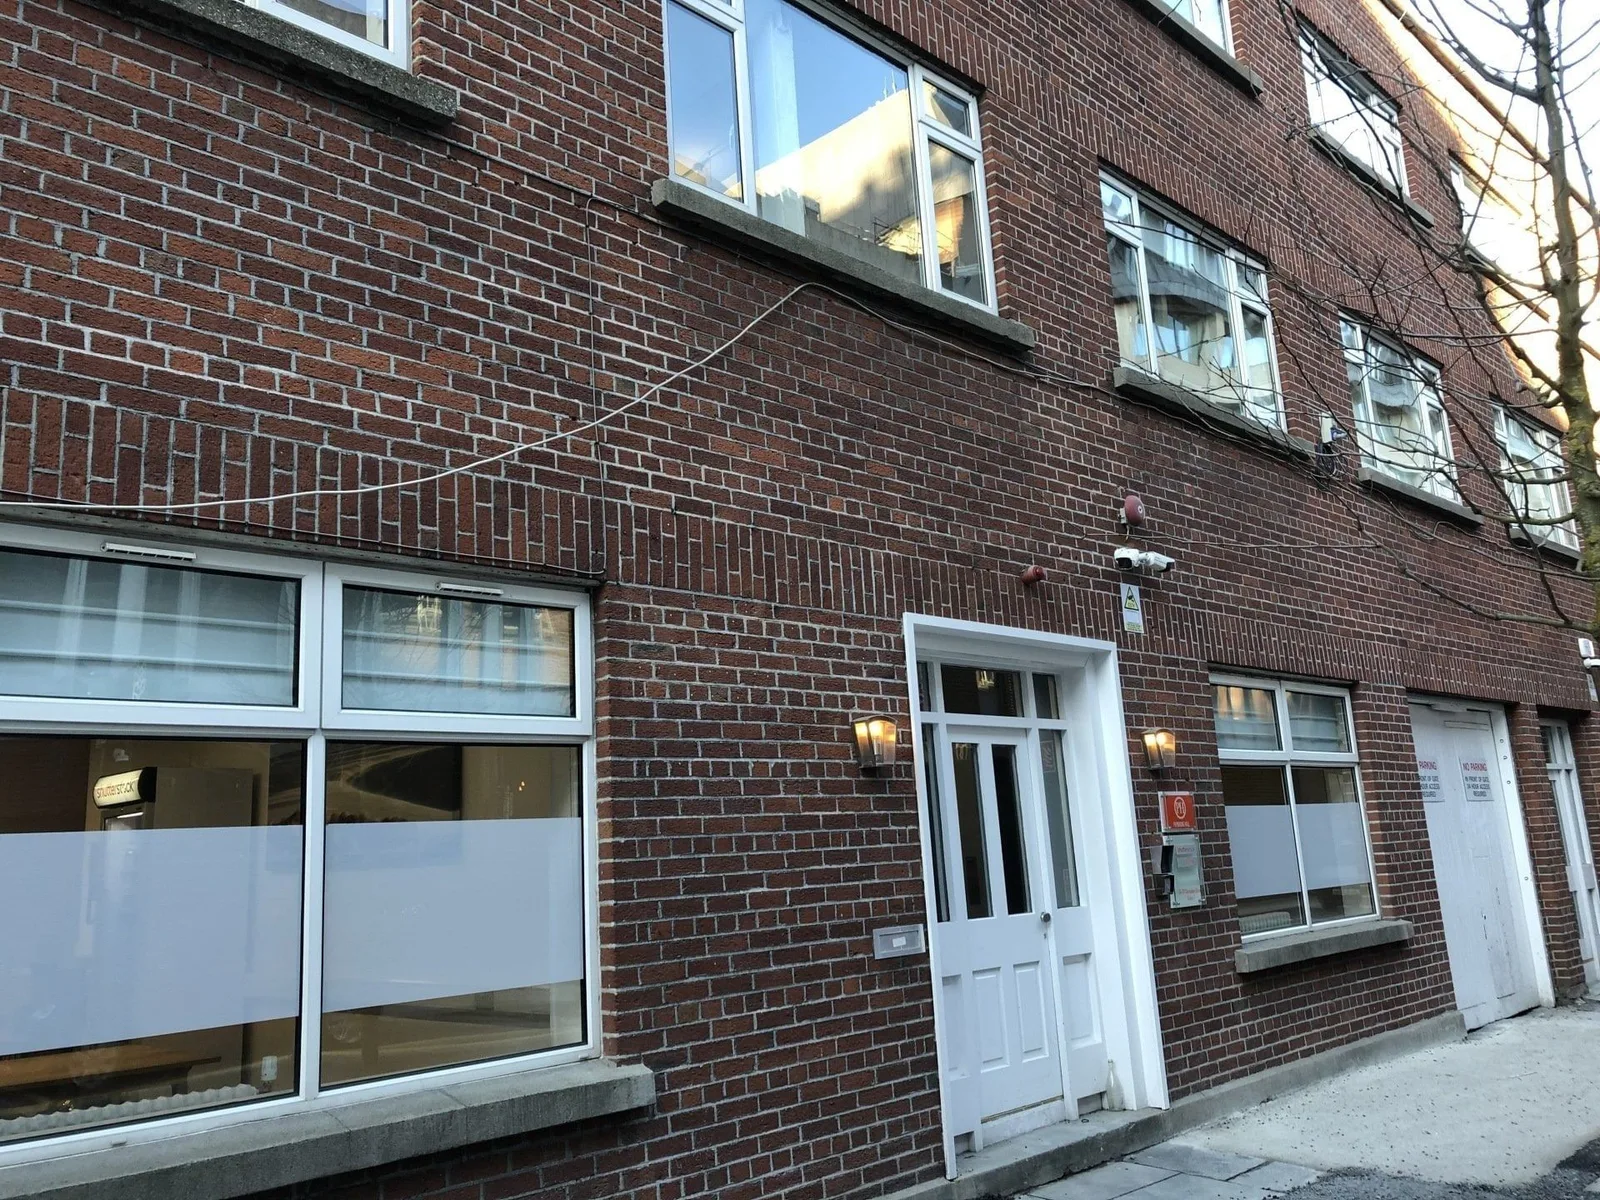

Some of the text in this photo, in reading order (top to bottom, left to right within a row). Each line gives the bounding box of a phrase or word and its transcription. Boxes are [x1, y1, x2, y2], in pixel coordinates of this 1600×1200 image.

[1419, 761, 1437, 770] PARKING
[1463, 763, 1487, 771] NO PARKING
